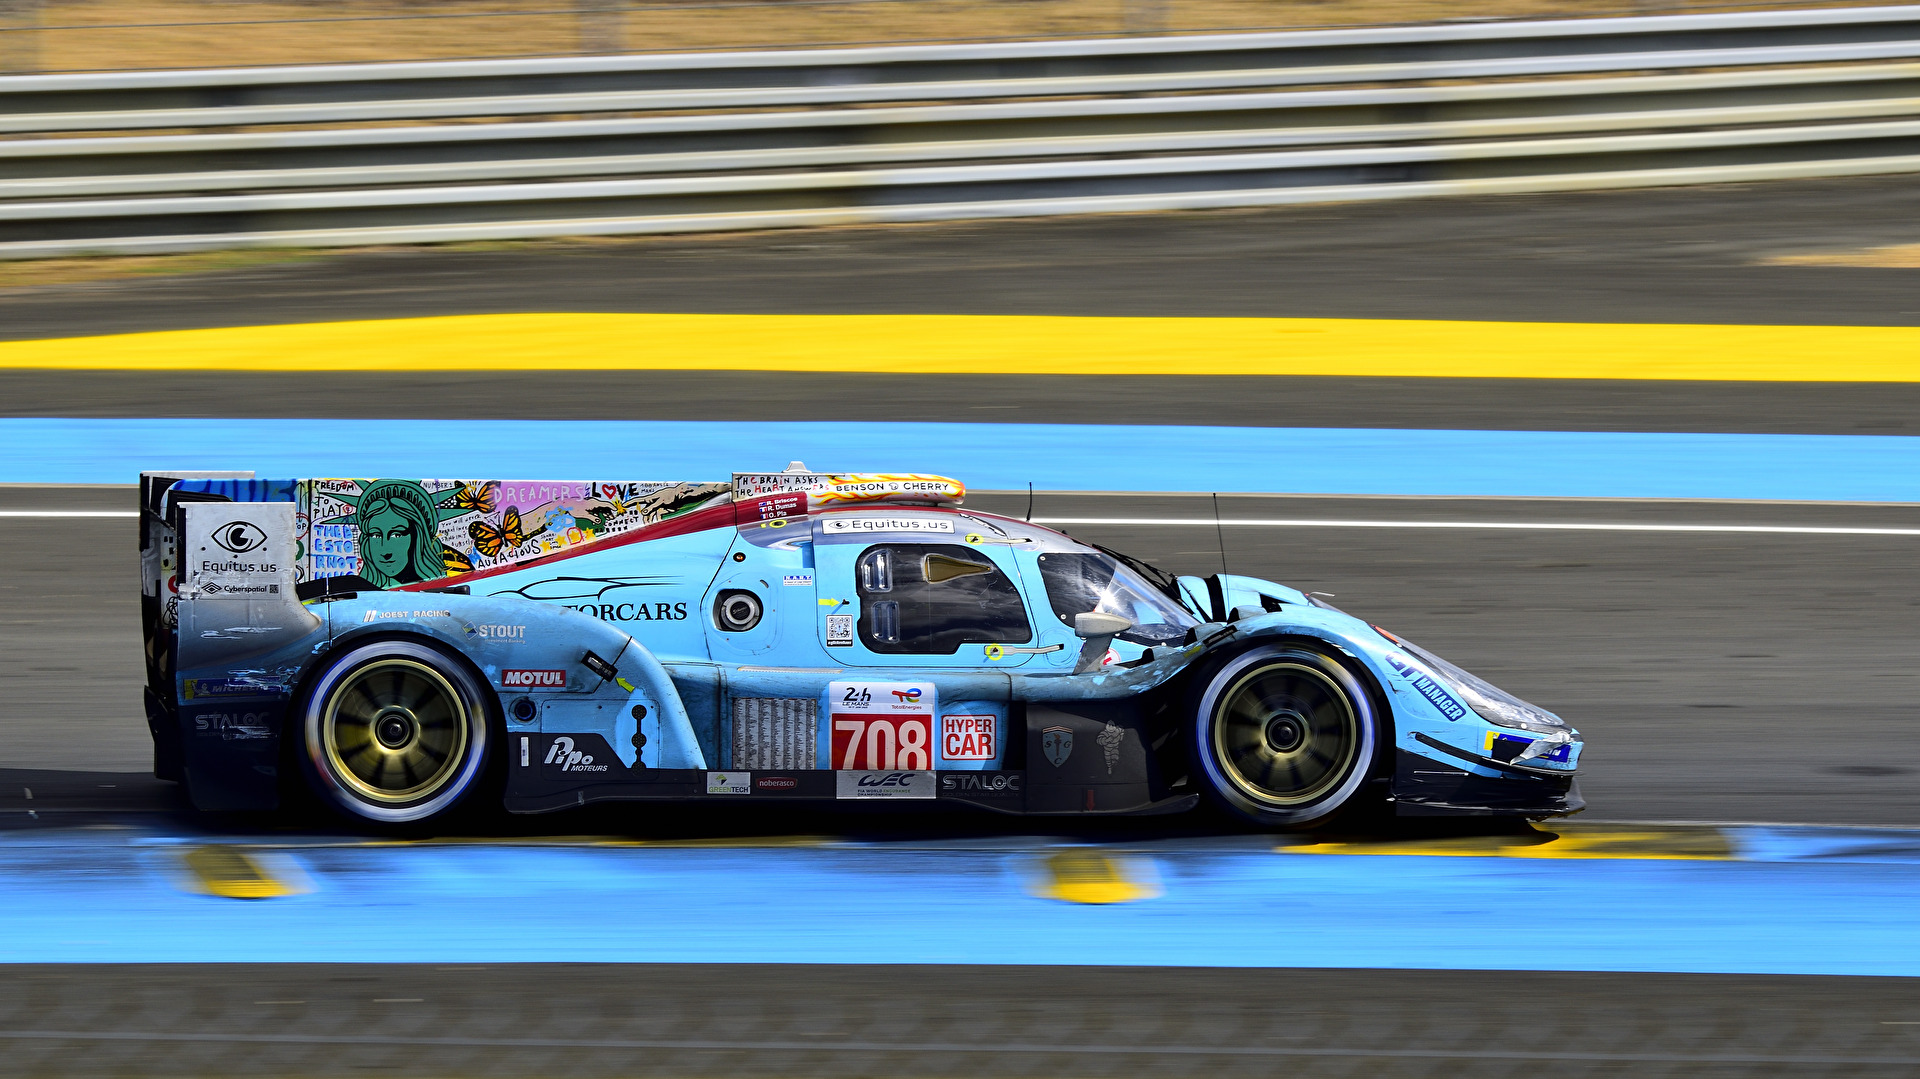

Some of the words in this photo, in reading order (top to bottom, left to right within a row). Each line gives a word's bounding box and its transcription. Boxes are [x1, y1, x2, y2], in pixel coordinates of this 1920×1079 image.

[836, 483, 884, 492] BENSON
[903, 482, 948, 491] CHERRY
[494, 486, 585, 503] DREAMERS
[313, 503, 344, 518] PLAY
[852, 519, 948, 530] Equitus.us
[202, 561, 277, 574] Equitus.us
[224, 585, 267, 593] Cyberspatial
[379, 611, 408, 619] JOEST
[413, 610, 450, 618] RACING
[562, 602, 687, 621] ORCARS
[479, 625, 526, 638] STOUT
[504, 671, 563, 685] MOTUL
[1415, 677, 1465, 721] MANAGER
[945, 719, 992, 733] HYPER
[835, 720, 928, 770] 708
[945, 733, 992, 756] CAR
[759, 779, 795, 787] noberasco
[943, 775, 1019, 790] STALOC
